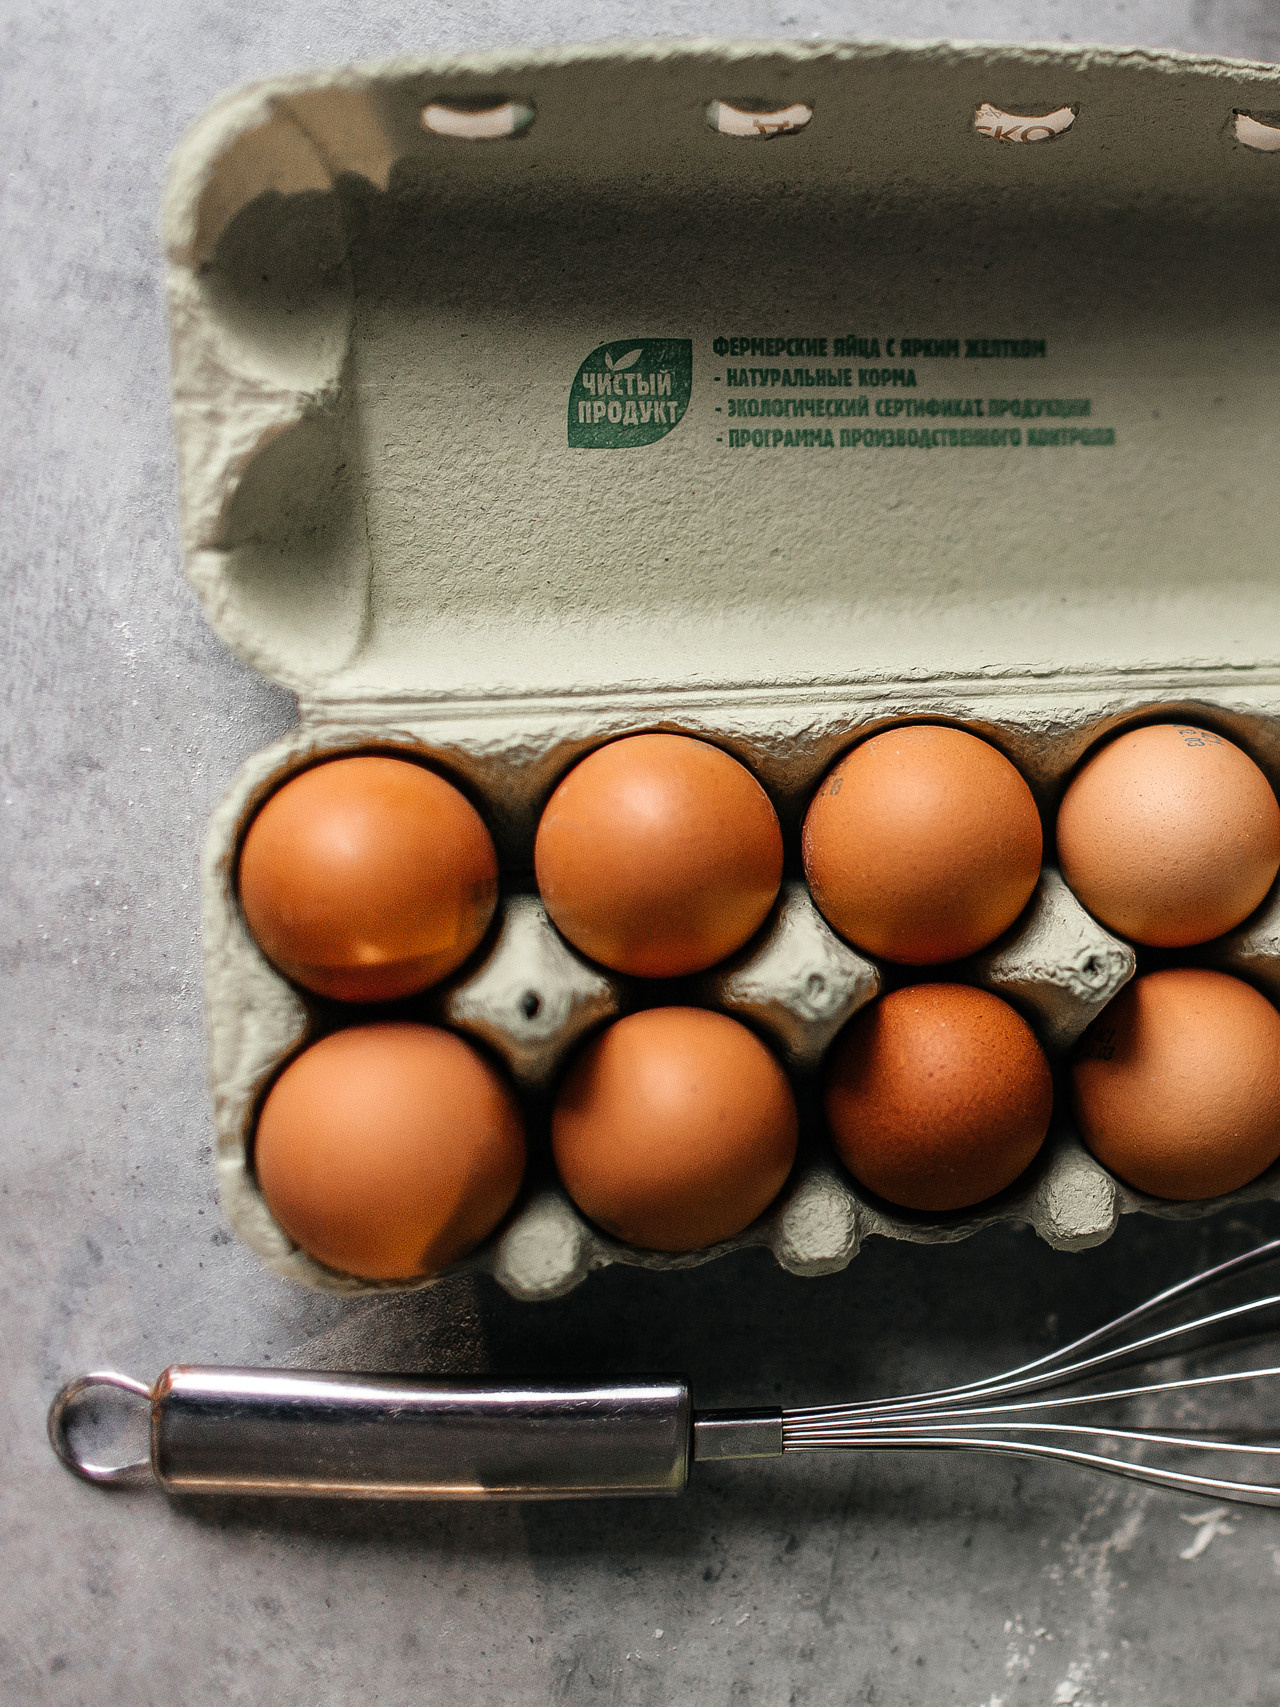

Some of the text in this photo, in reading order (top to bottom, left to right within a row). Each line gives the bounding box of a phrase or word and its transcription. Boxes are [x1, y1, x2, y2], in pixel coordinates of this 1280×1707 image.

[713, 336, 828, 357] ФЕРМЕРСКИЕ
[833, 334, 881, 359] ЯЙЦА
[886, 338, 895, 357] С
[901, 338, 960, 358] ЯРКИМ
[582, 370, 672, 396] ЧИСТЫЙ
[727, 368, 917, 387] НАТУРАЛЬНЫЕ КОРМА
[578, 400, 679, 426] ПРОДУКТ
[727, 395, 869, 418] ЭКОЛОГИЧЕСКИЙ
[729, 428, 835, 447] ПРОГРАММА
[840, 428, 1022, 449] ПРОИЗВОДСТВЕННОГО
